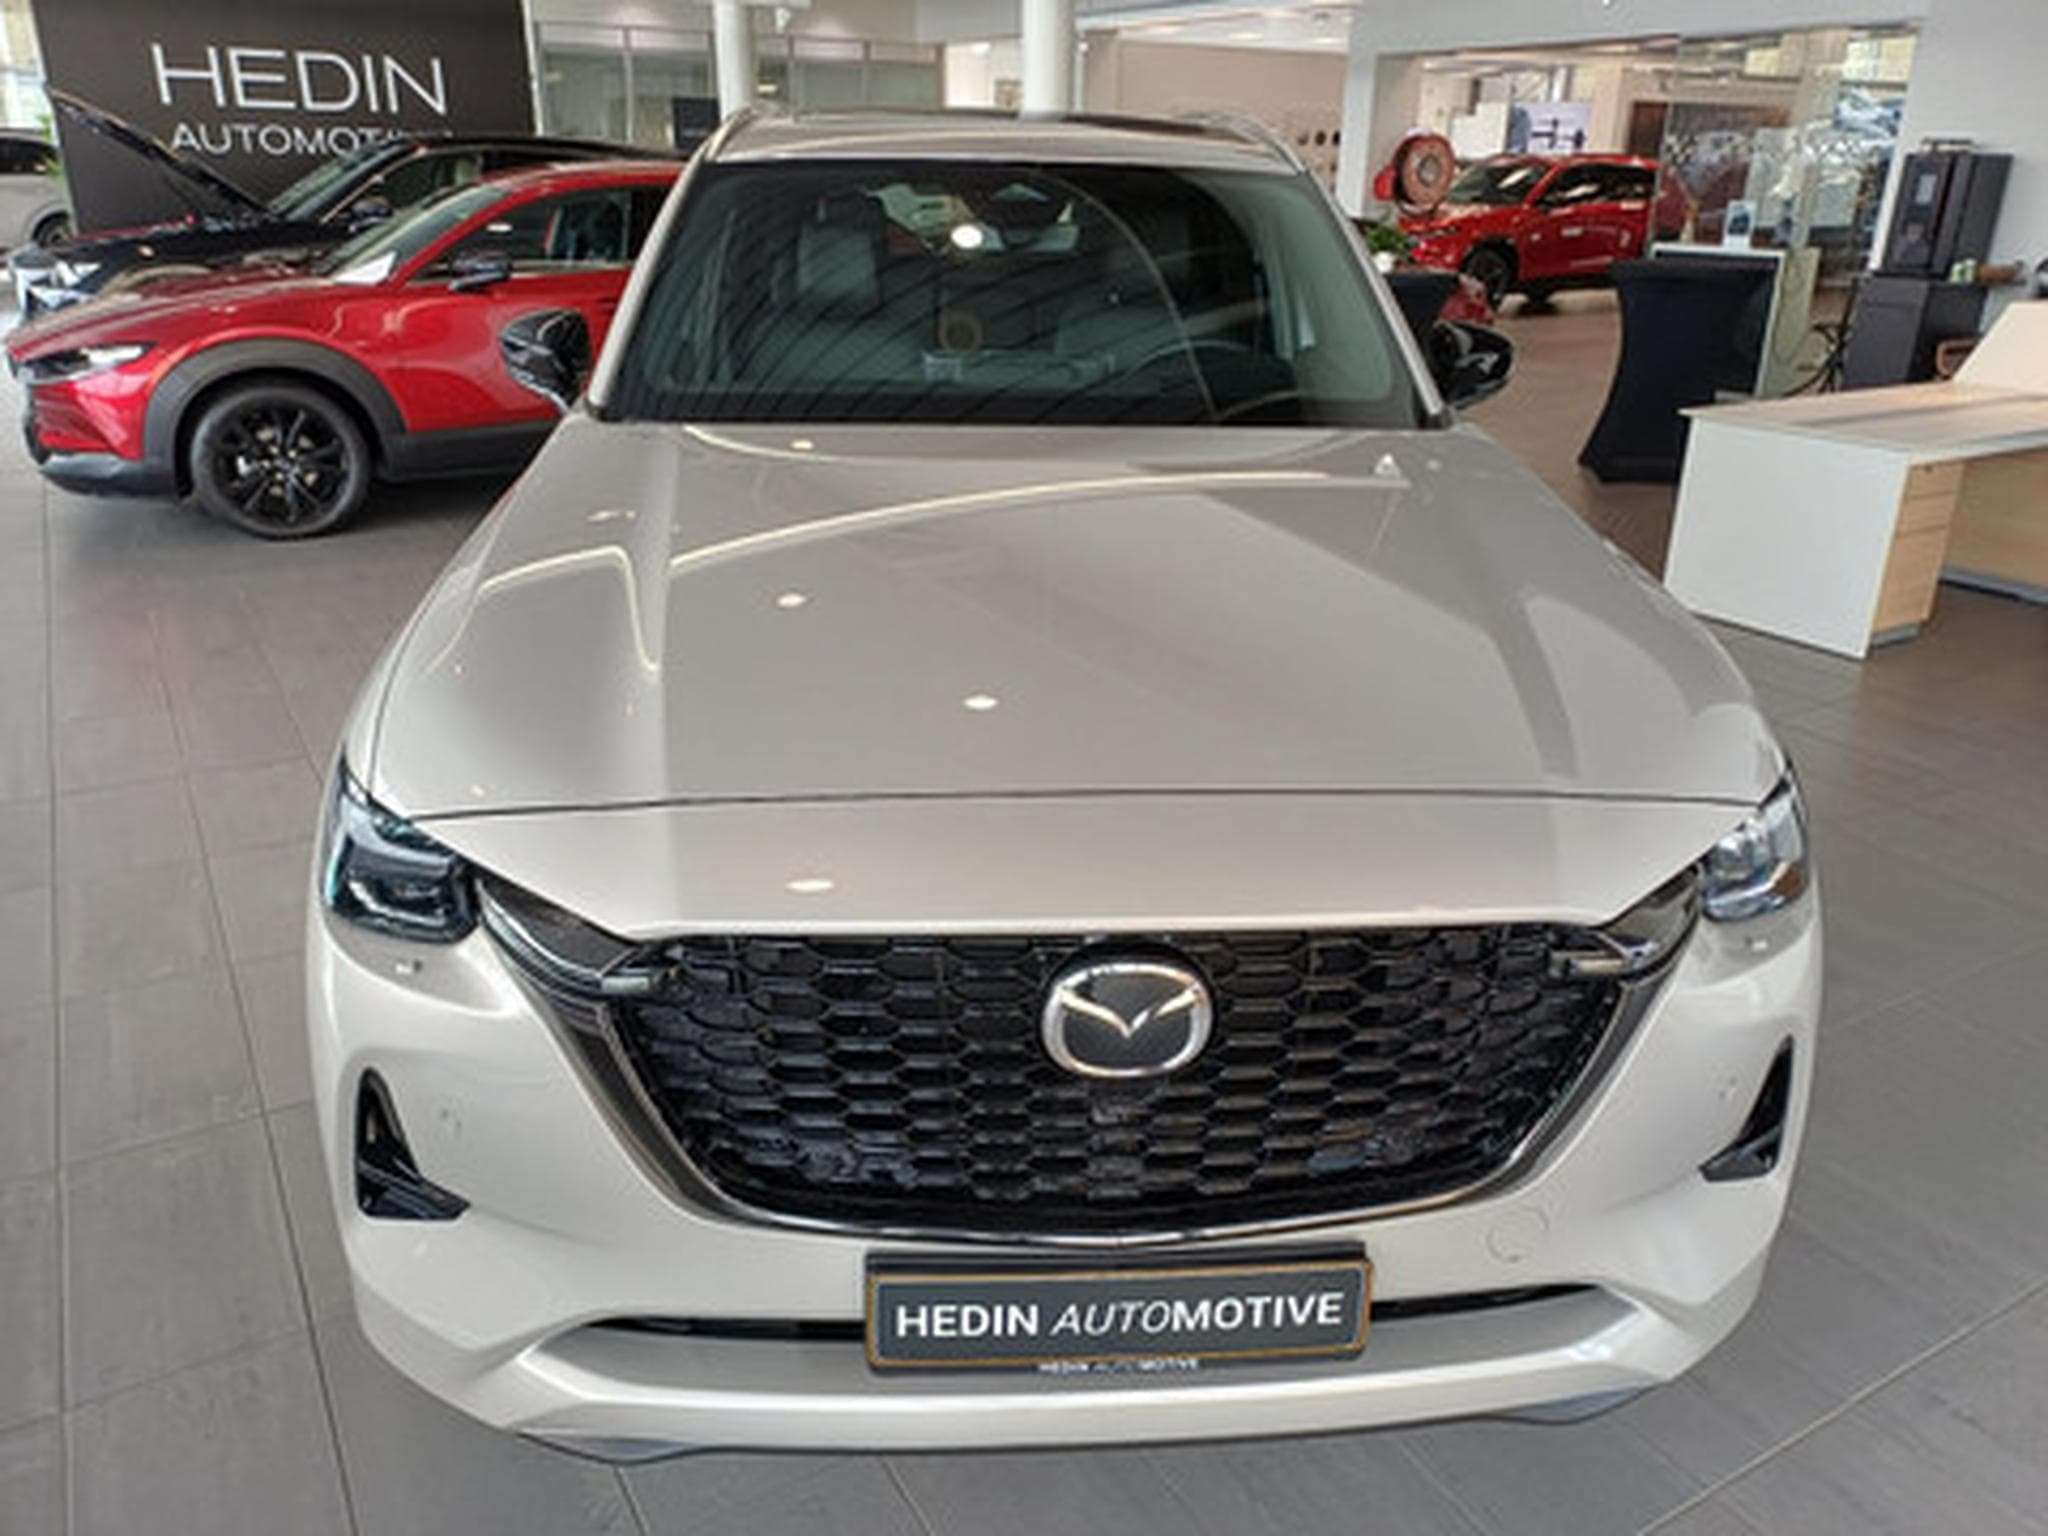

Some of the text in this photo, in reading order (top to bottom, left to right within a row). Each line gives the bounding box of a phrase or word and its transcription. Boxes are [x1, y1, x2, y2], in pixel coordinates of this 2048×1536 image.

[152, 42, 447, 115] HEDIN
[896, 1291, 1344, 1338] HEDIN AUTOMOTIVE
